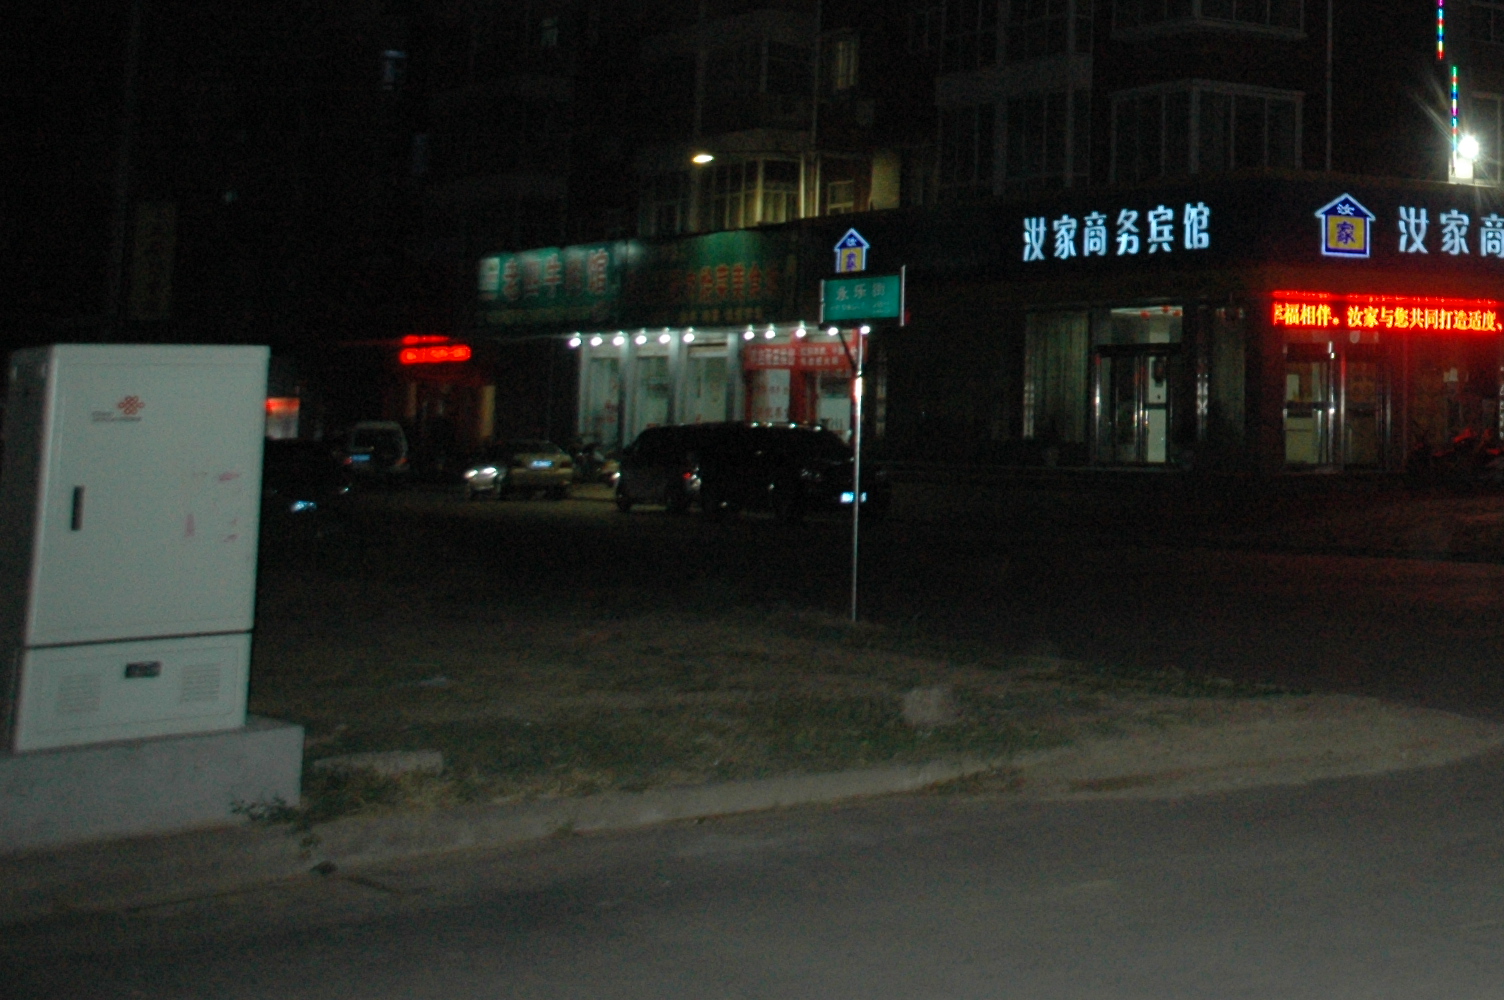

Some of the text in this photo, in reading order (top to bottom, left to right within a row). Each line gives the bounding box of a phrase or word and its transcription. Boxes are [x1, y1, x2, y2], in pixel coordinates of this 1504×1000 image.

[1022, 201, 1211, 263] 汝家商务宾馆
